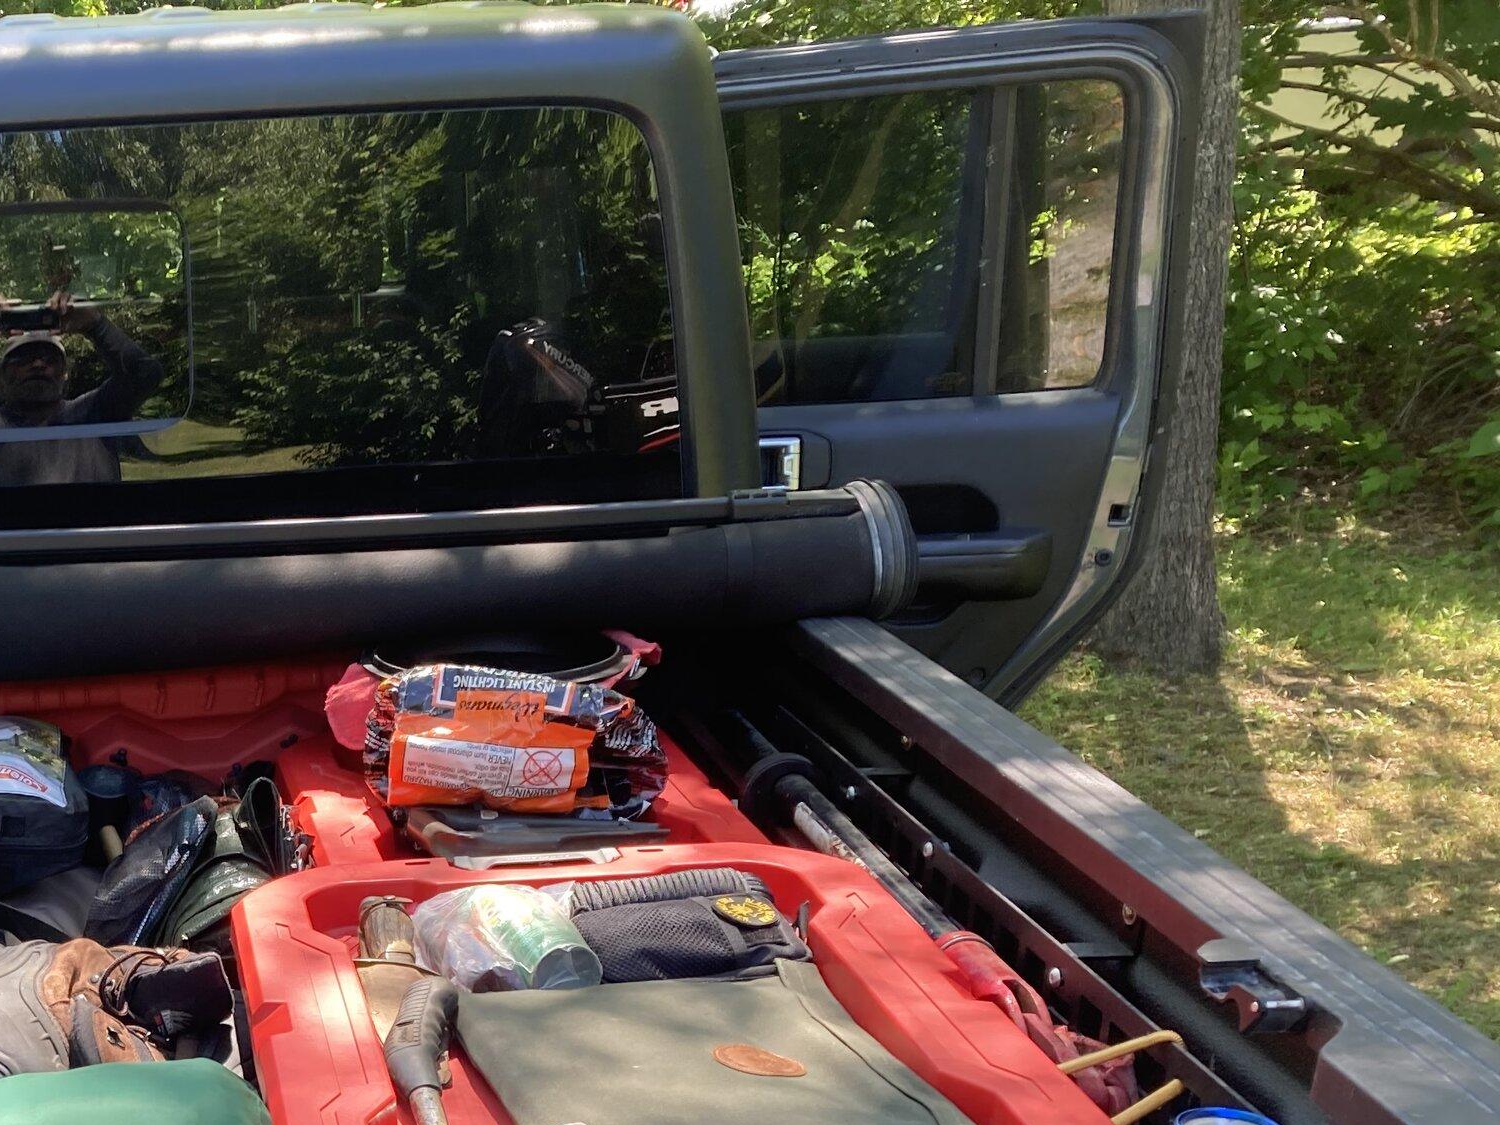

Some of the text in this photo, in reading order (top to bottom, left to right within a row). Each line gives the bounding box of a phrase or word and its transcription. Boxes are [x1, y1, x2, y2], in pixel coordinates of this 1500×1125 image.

[453, 675, 555, 693] INSTANT LIGHTING
[457, 692, 539, 722] Wegmans
[488, 754, 513, 764] NEVER
